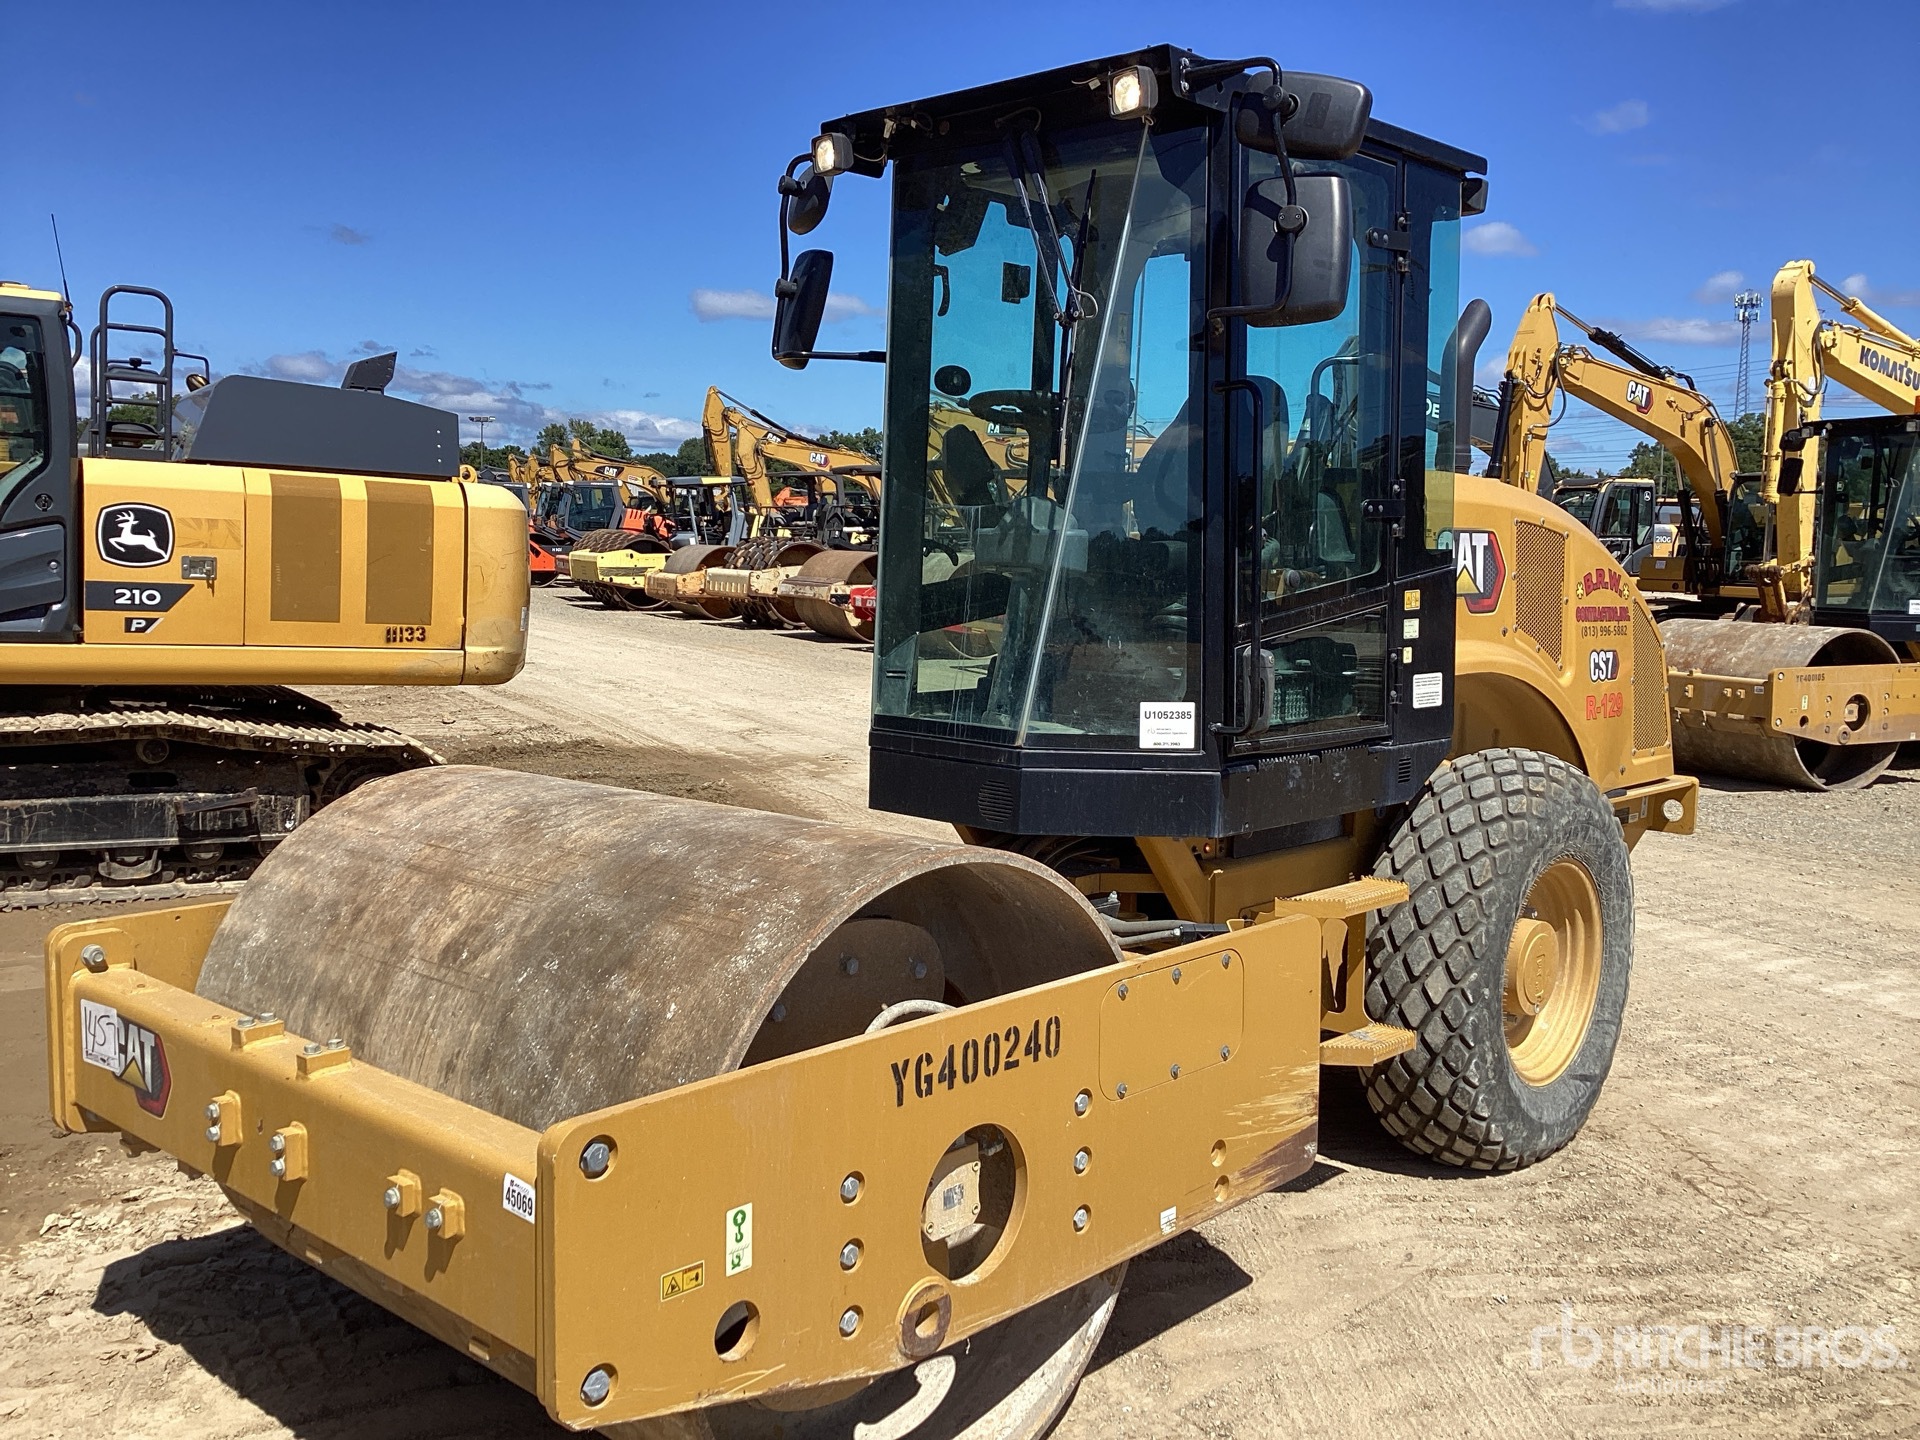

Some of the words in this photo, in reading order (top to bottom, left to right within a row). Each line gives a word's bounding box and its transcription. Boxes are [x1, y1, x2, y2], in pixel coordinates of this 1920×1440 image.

[1859, 345, 1920, 391] KOMATSU
[1627, 380, 1649, 407] CAT
[604, 466, 617, 478] CAT
[810, 453, 826, 465] CAT
[1583, 567, 1623, 598] B.R.W.
[115, 588, 161, 605] 210
[130, 619, 146, 632] P
[1581, 625, 1599, 639] (813)
[1589, 650, 1614, 681] CS7
[1144, 710, 1192, 720] U1052385
[1585, 691, 1624, 721] R-129
[890, 1015, 1061, 1108] YG400240
[505, 1186, 533, 1217] 45069
